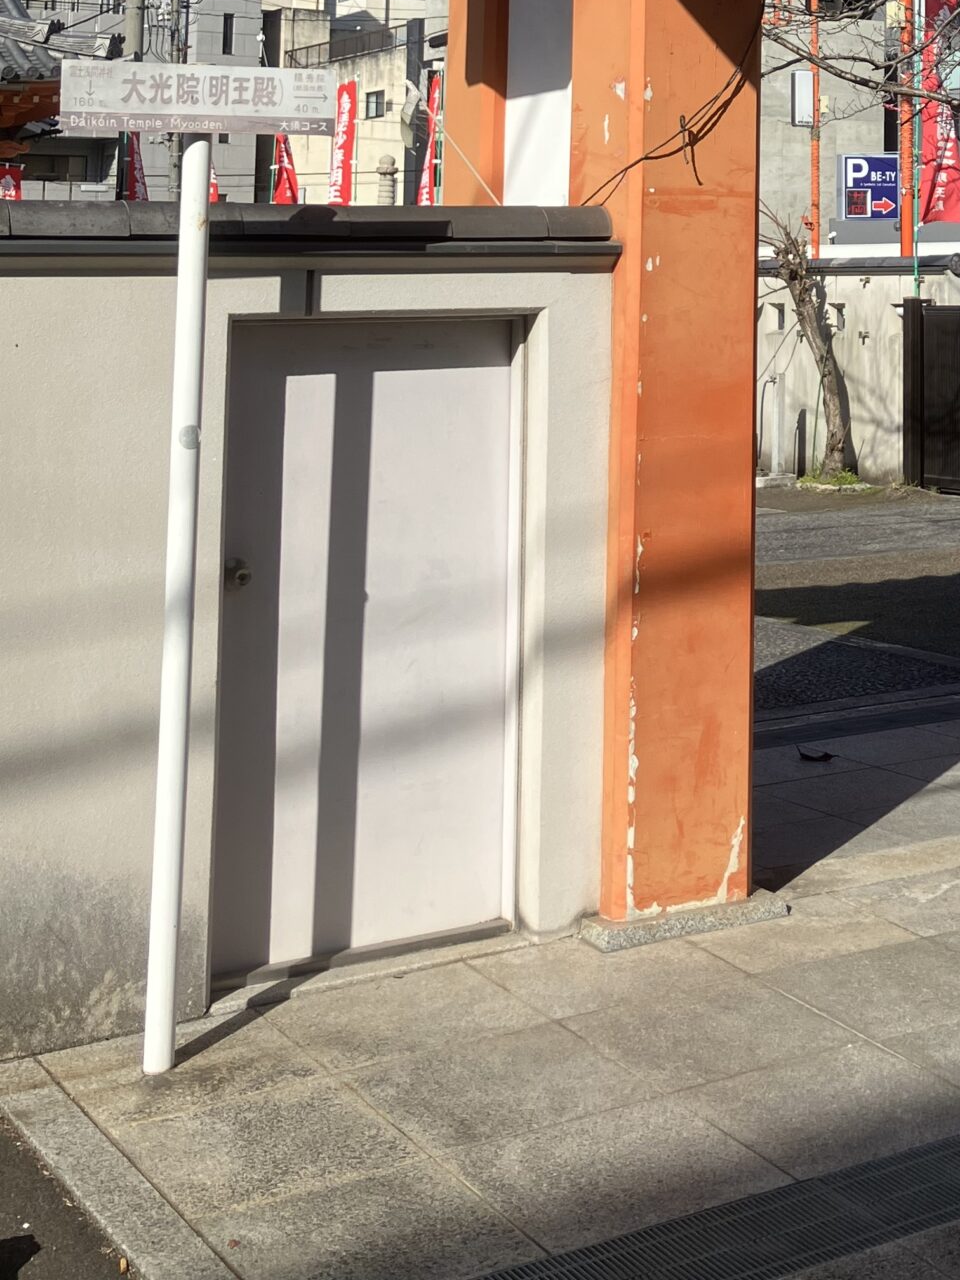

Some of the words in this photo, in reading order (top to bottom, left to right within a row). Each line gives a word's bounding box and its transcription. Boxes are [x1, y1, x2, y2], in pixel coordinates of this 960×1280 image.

[120, 71, 284, 108] 大光院(明王殿)
[121, 116, 163, 130] Temple
[279, 120, 328, 132] 大須コース
[847, 158, 869, 188] P
[870, 171, 897, 182] BE-TY
